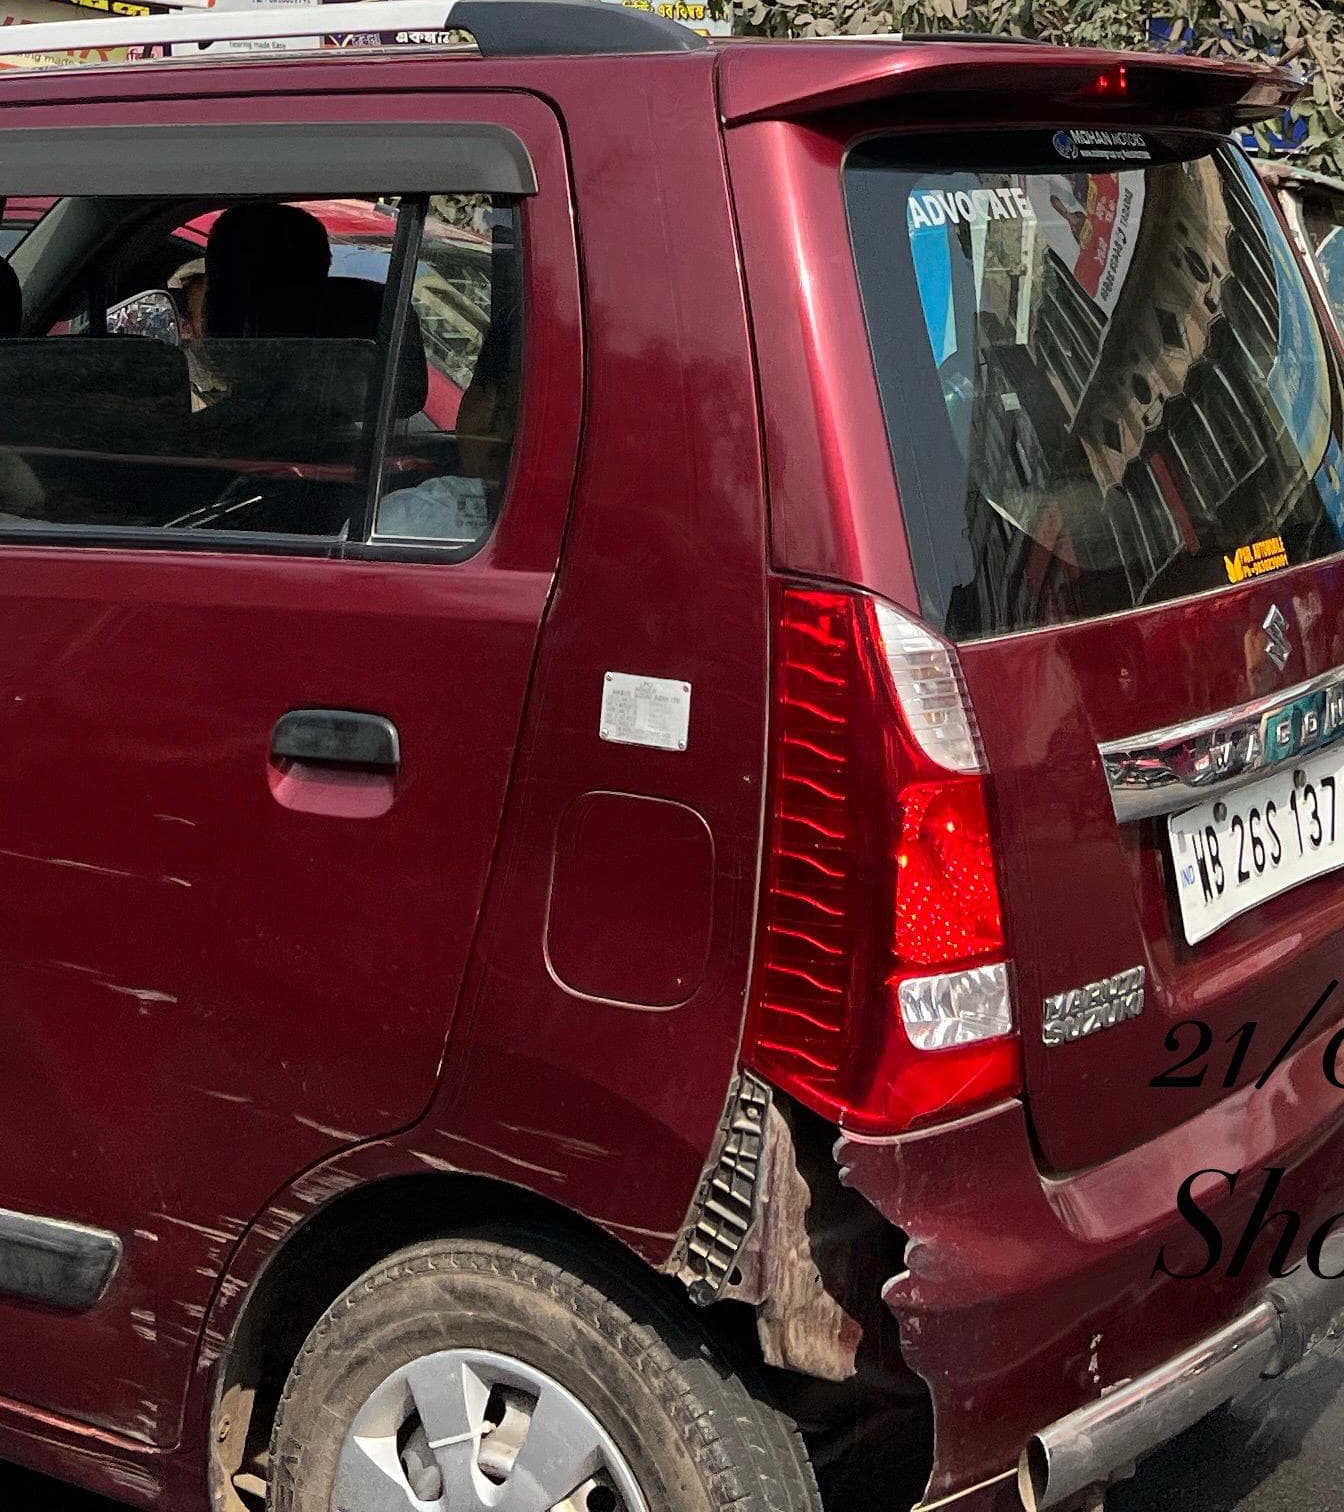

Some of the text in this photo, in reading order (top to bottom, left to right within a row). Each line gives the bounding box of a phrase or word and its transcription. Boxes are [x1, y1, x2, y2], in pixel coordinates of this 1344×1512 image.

[908, 188, 1034, 231] ADVOCATE
[1192, 825, 1225, 906] WB
[1231, 801, 1282, 884] 26S
[1043, 986, 1146, 1048] SUZUKI
